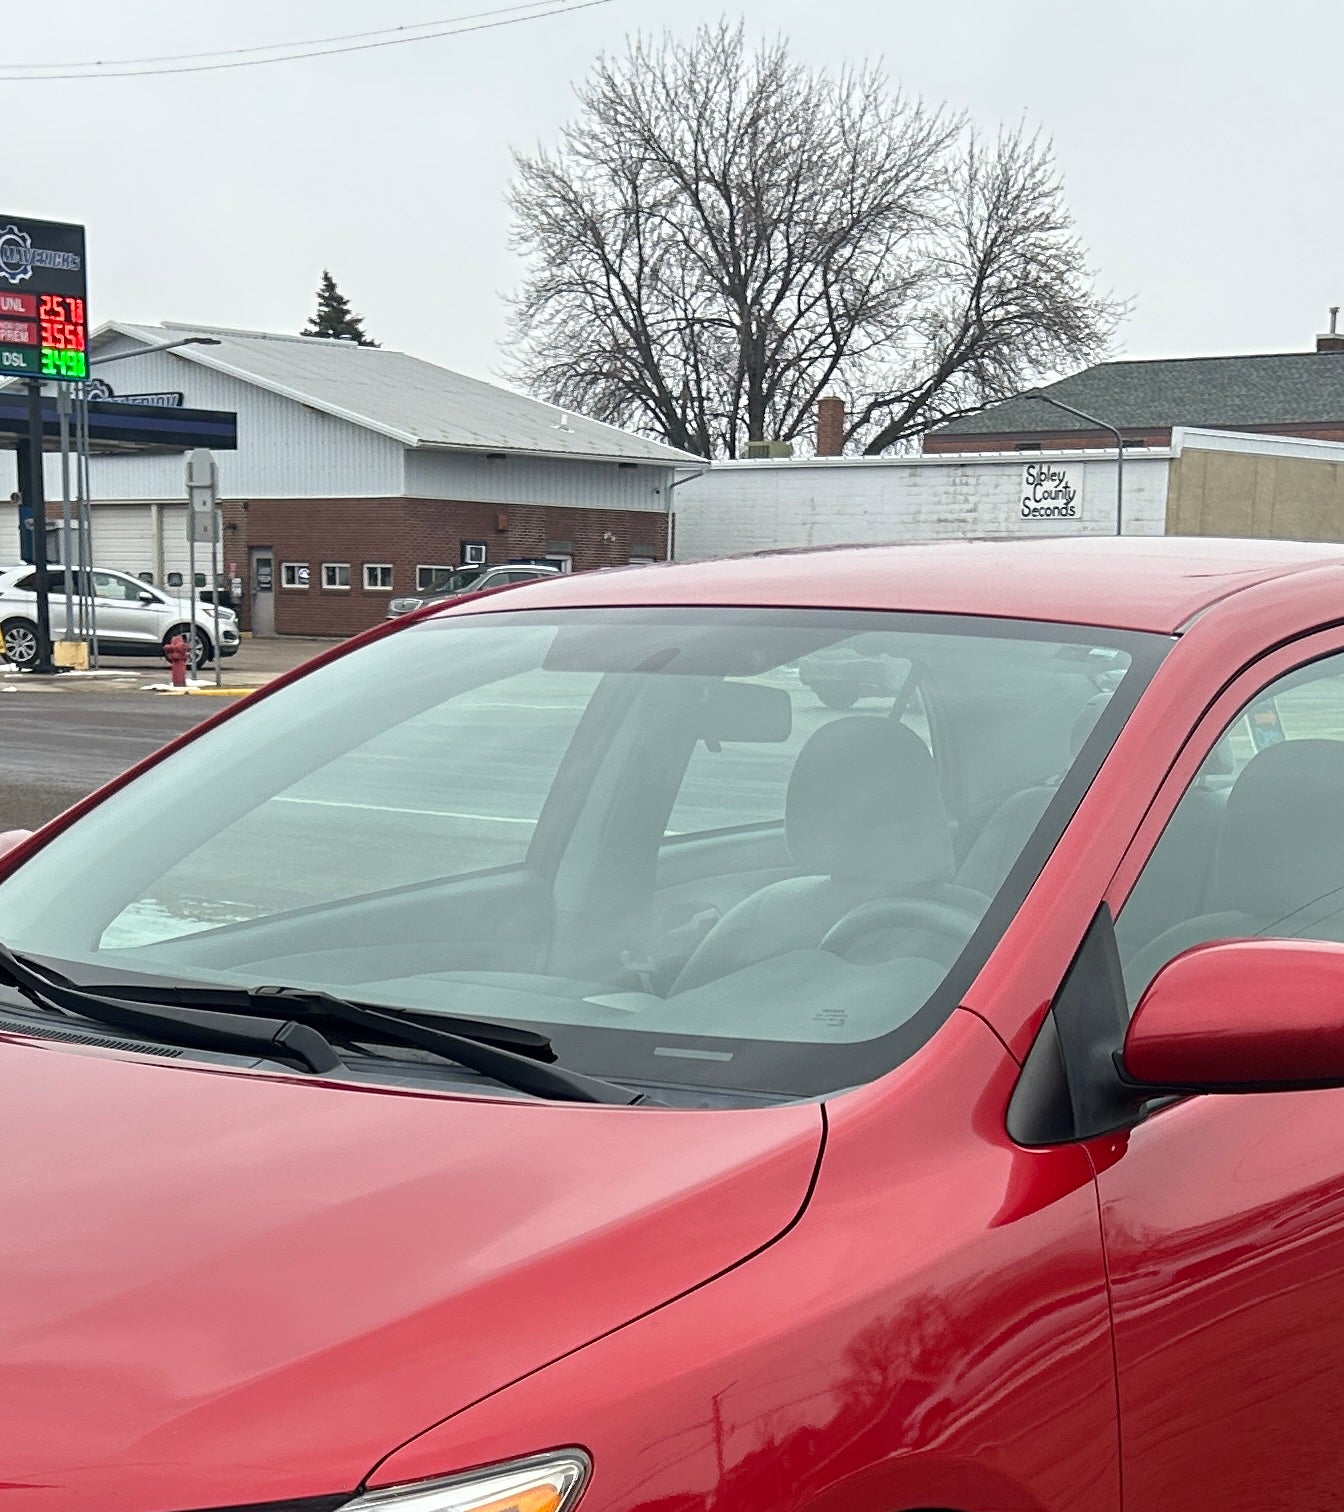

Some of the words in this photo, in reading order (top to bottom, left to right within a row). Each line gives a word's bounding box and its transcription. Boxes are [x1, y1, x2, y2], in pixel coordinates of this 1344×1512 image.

[0, 296, 26, 312] UNL
[2, 352, 27, 367] DSL
[1025, 464, 1066, 488] Sibley
[1033, 481, 1076, 506] County
[1021, 497, 1076, 517] Seconds
